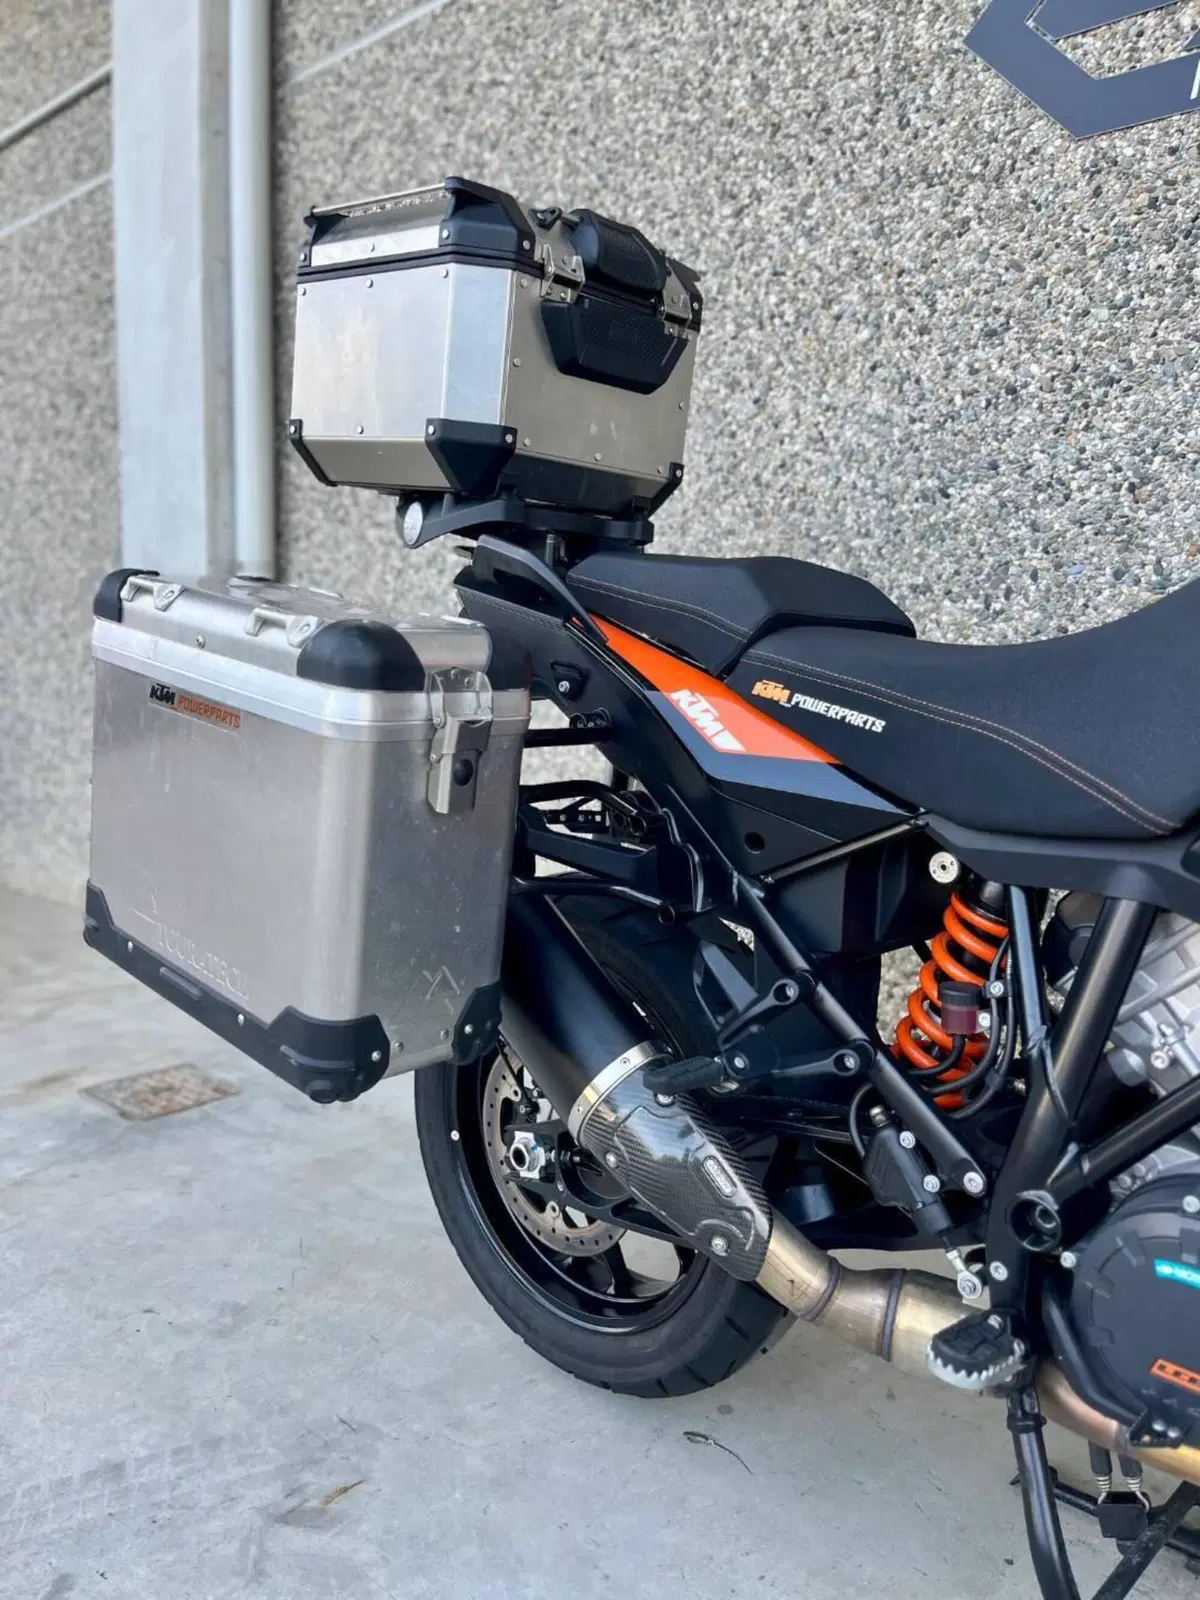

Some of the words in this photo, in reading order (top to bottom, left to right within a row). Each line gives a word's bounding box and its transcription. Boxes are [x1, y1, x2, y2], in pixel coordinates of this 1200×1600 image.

[149, 683, 176, 705] KTM
[669, 688, 725, 736] KTM
[751, 679, 791, 704] KTM
[790, 693, 887, 733] POWERPARTS
